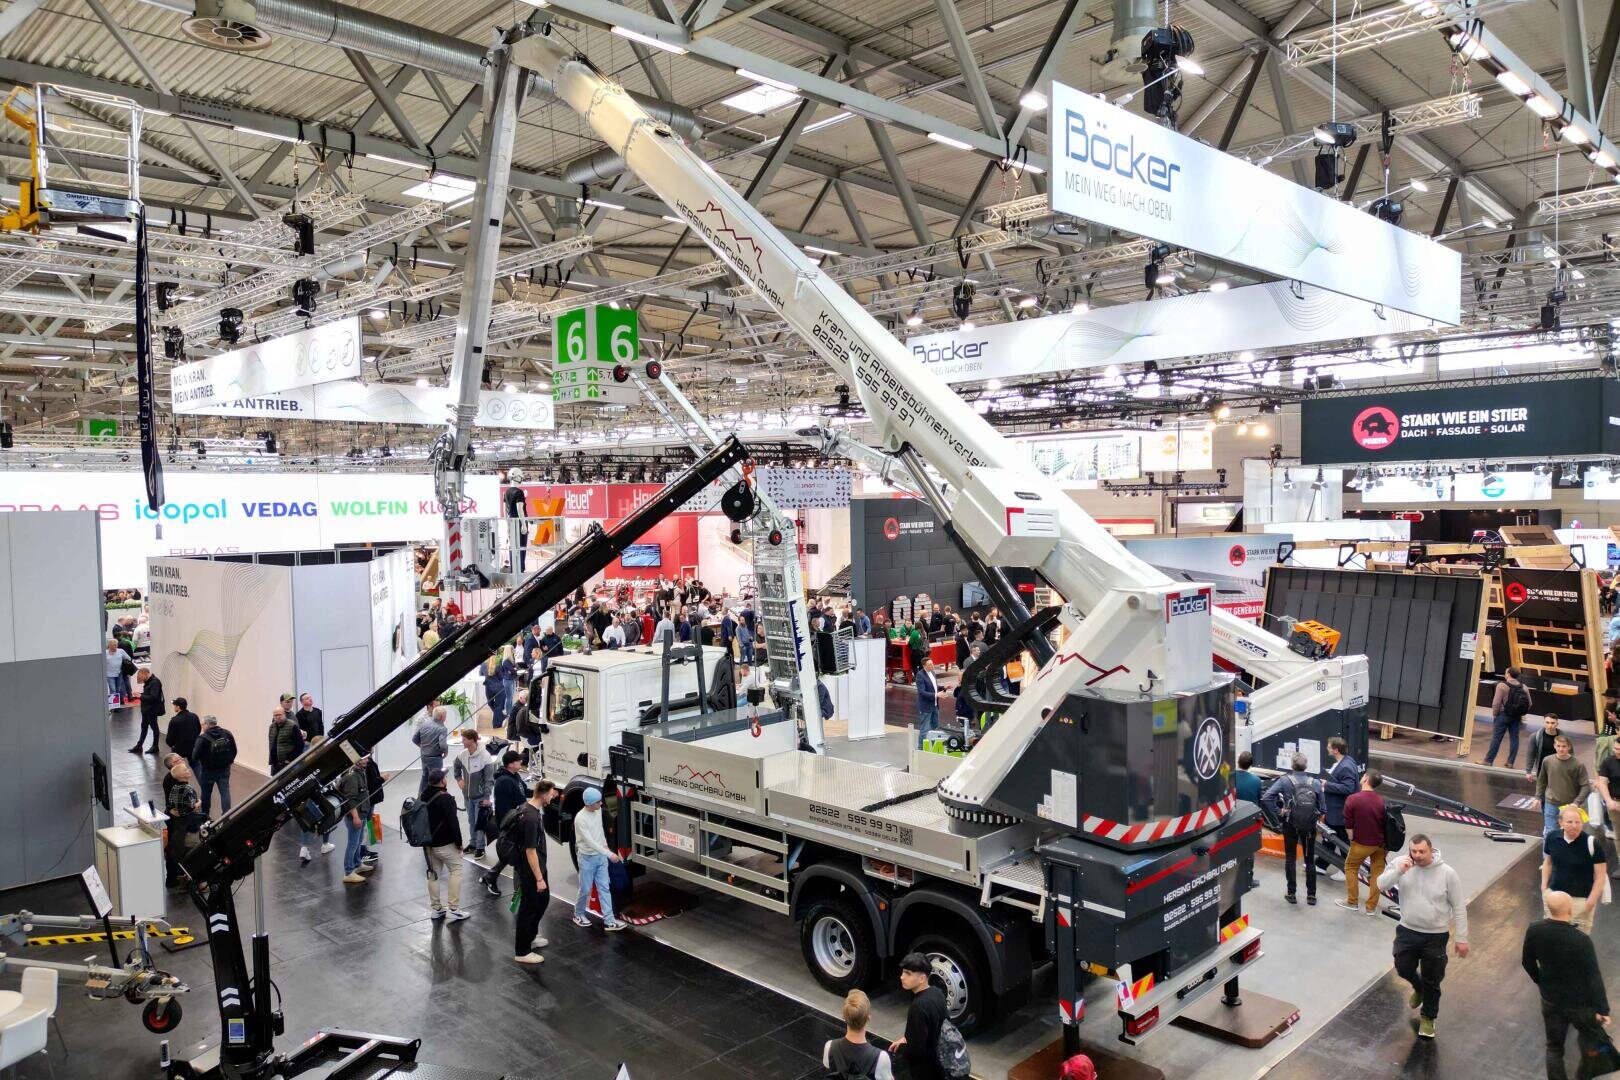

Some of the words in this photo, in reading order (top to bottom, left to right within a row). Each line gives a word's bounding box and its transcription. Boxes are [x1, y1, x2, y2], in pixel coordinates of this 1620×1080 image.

[1066, 109, 1180, 192] Böcker
[1065, 171, 1091, 198] MEIN
[1093, 180, 1116, 203] WEG
[1119, 187, 1145, 212] NACH
[1148, 198, 1172, 221] OBEN
[676, 200, 712, 239] HERSING
[713, 234, 757, 282] DACHBAU
[757, 278, 785, 310] GMBH
[567, 321, 584, 362] 6
[610, 324, 634, 364] 6
[819, 310, 848, 342] Kran-
[849, 340, 871, 364] und
[913, 339, 989, 364] Böcker
[812, 324, 850, 365] 02522
[855, 366, 881, 394] 595
[880, 389, 898, 411] 99
[898, 407, 915, 428] 97
[174, 390, 189, 404] MEIN
[190, 384, 216, 400] ANTRIEB.
[233, 398, 304, 412] ANTRIEB.
[1401, 429, 1428, 438] DACH
[1436, 425, 1481, 437] FASSADE
[1491, 423, 1526, 435] SOLAR
[1402, 414, 1440, 428] STARK
[1442, 411, 1467, 425] WIE
[1469, 409, 1489, 423] EIN
[1491, 407, 1528, 422] STIER
[136, 499, 227, 524] icopal
[242, 501, 318, 518] VEDAG
[331, 500, 409, 516] WOLFIN
[565, 489, 589, 510] Heuel
[150, 565, 163, 577] MEIN
[164, 567, 181, 579] KRAN.
[151, 581, 164, 594] MEIN
[165, 583, 190, 598] ANTRIEB.
[1171, 595, 1207, 615] Böcker
[1316, 681, 1326, 692] 80
[660, 774, 688, 788] HERSING
[690, 781, 724, 797] DACHBAU
[725, 790, 746, 802] GMBH
[809, 803, 840, 819] 02522
[847, 813, 868, 826] 595
[869, 819, 883, 829] 99
[885, 823, 898, 834] 97
[1163, 882, 1191, 905] HERSING
[1191, 866, 1220, 889] DACHBAU
[1220, 858, 1237, 874] GMBH
[1163, 903, 1187, 923] 02522
[1190, 893, 1203, 908] 595
[1204, 887, 1213, 900] 99
